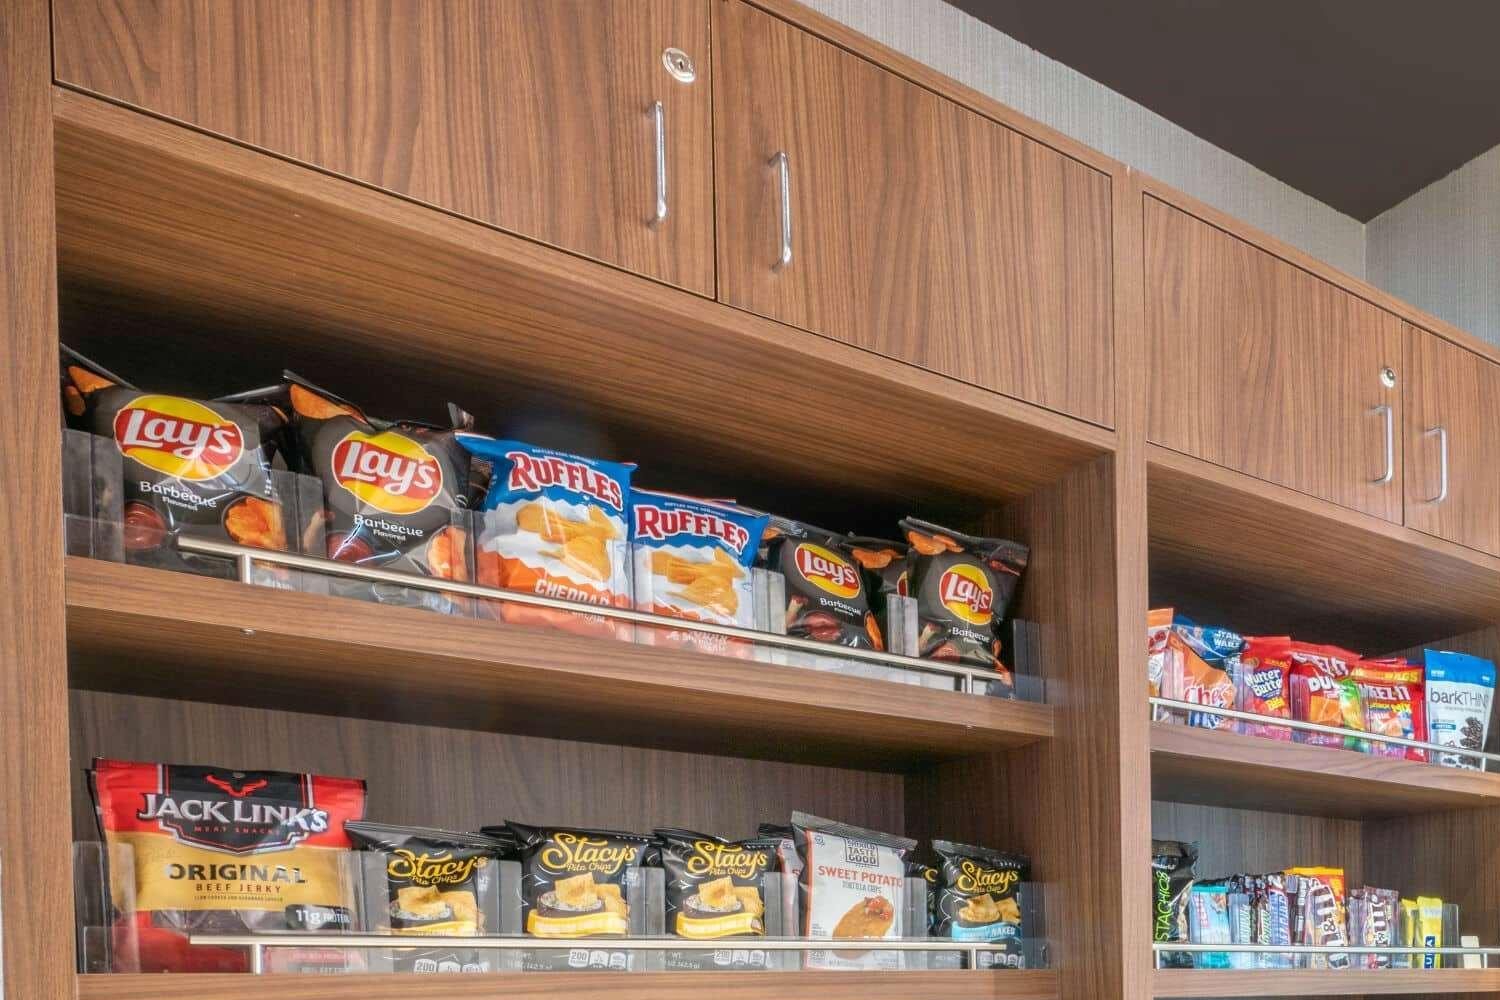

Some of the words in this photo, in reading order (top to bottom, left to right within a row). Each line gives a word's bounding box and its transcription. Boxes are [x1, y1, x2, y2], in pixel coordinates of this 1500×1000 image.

[123, 409, 235, 460] Lay's
[341, 441, 436, 496] Lay's
[505, 452, 623, 512] RUFFLES
[139, 480, 217, 508] Barbecue
[353, 513, 424, 538] Barbecue
[634, 504, 749, 555] RUFFLES
[803, 550, 857, 586] Lay's
[946, 573, 991, 613] Lay's
[1247, 669, 1281, 687] Nutter
[136, 793, 231, 824] JACK
[232, 798, 328, 833] LINK'S
[387, 849, 489, 885] Stacy's
[541, 832, 639, 875] Stacy's
[687, 840, 769, 879] Stacy's
[848, 847, 877, 857] TASTE
[848, 854, 877, 864] GOOD
[163, 861, 307, 885] ORIGINAL
[195, 882, 233, 893] BEEF
[239, 883, 283, 895] JERKY
[818, 865, 859, 882] SWEET
[861, 872, 904, 888] POTATO
[957, 860, 1018, 894] Stacy's
[295, 906, 322, 924] 11g
